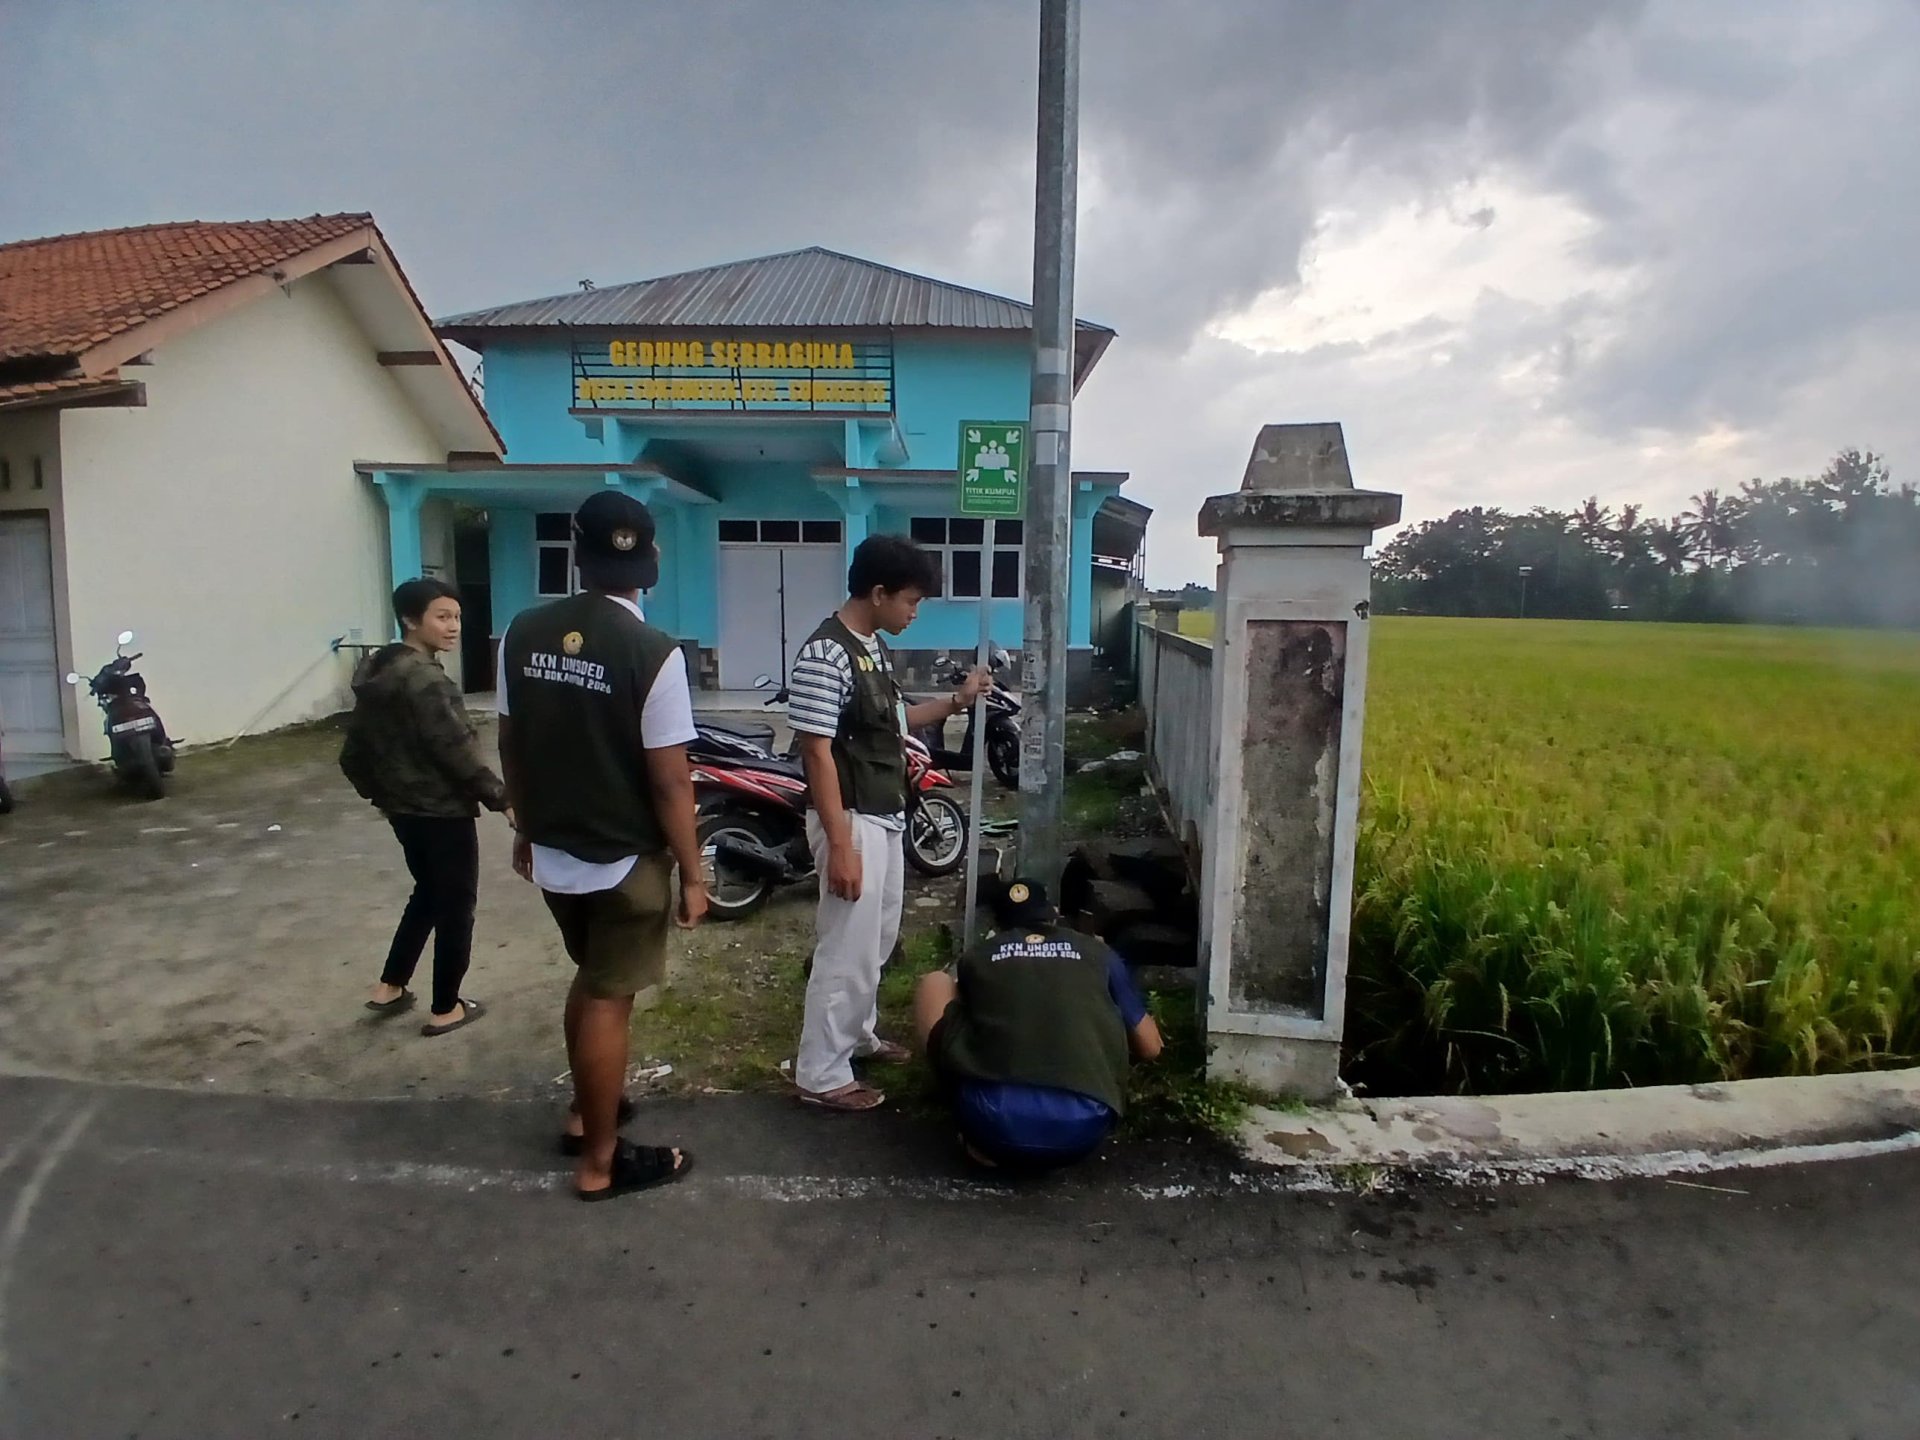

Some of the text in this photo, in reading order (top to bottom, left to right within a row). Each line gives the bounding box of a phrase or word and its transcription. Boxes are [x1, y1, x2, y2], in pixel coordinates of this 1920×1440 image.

[609, 340, 855, 369] GEDUNG SERBAGUNA
[531, 653, 604, 680] KKN UNSOED
[1000, 942, 1072, 952] KKN UNSOED
